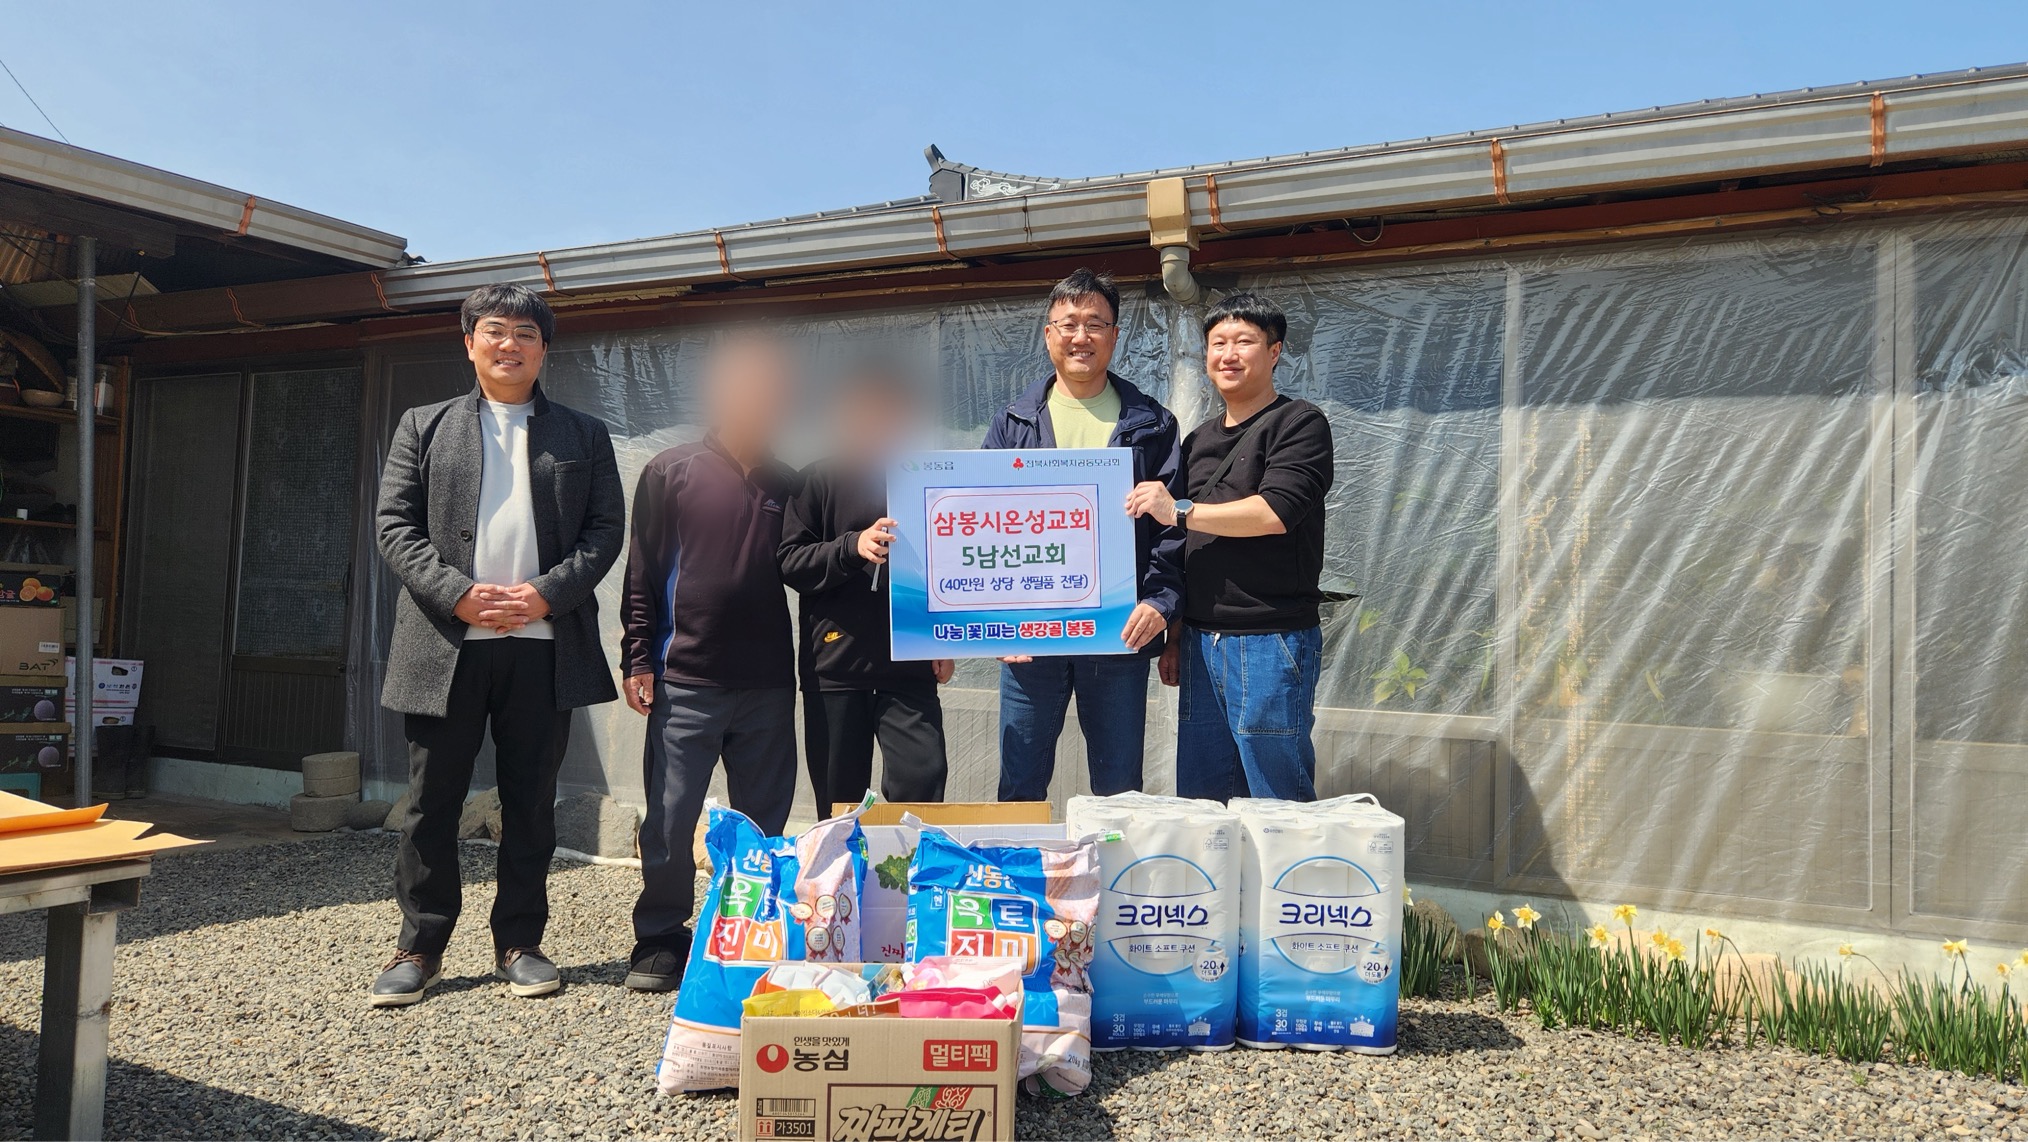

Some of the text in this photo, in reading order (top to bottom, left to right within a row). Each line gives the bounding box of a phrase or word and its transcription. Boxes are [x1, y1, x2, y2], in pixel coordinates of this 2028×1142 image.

[923, 461, 954, 471] 봉동읍
[1026, 458, 1120, 468] 전북사회복지공동모금회
[933, 508, 1090, 537] 삼봉시온성교회
[962, 543, 1066, 569] 5남선교회
[939, 574, 1089, 594] (40만원 상당 생필품 전달)
[935, 620, 1096, 640] 나눔 꽃 피는 생강골 봉동
[19, 662, 50, 671] BAT
[955, 898, 1029, 928] 옥토
[1116, 905, 1209, 928] 크리넥스
[1279, 904, 1373, 928] 크리넥스
[716, 921, 777, 958] 진미
[1129, 944, 1152, 953] 화이트
[1180, 944, 1196, 953] 쿠션
[1292, 942, 1358, 953] 화이트 소프트 쿠션
[882, 942, 905, 958] 진짜
[1113, 1024, 1125, 1033] 30
[1275, 1019, 1287, 1028] 30
[794, 1037, 850, 1047] 인생을 맛있게
[793, 1049, 850, 1072] 농심
[930, 1044, 991, 1068] 멀티팩
[1068, 1054, 1081, 1068] 20kg
[776, 1122, 812, 1135] 가3501
[833, 1104, 985, 1142] 짜파게티
